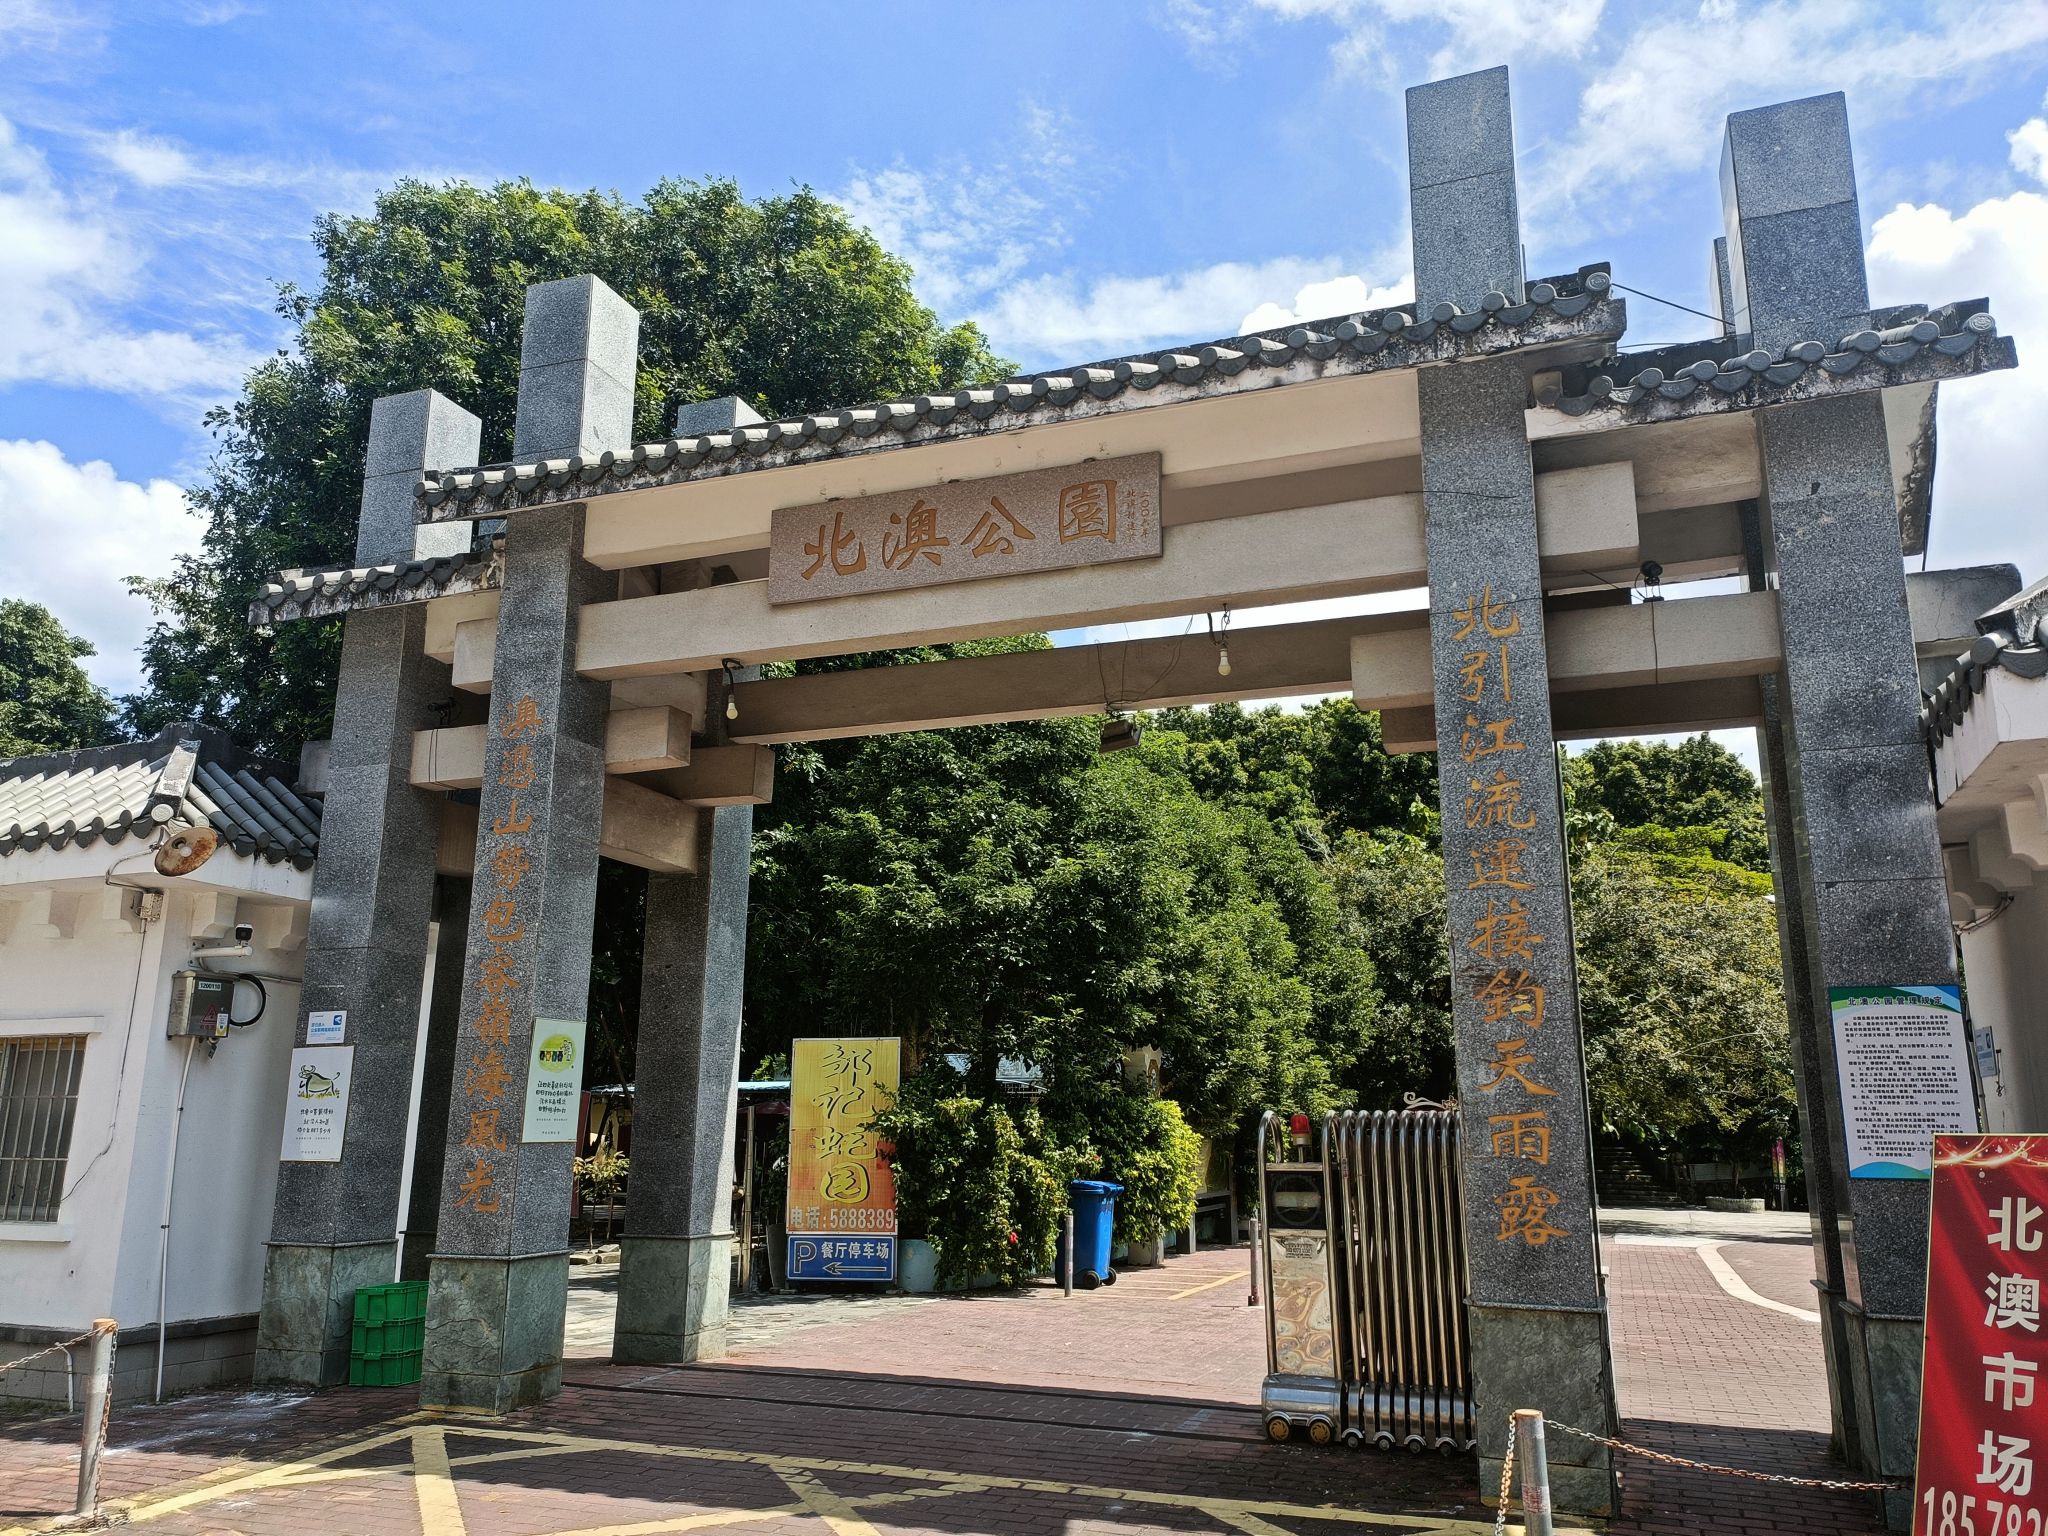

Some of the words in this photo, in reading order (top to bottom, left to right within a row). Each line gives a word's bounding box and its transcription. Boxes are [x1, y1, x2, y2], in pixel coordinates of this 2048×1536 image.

[801, 479, 1117, 581] 北澳公園
[1847, 995, 1943, 1006] 北澳公园管理规定
[821, 1241, 890, 1260] 餐厅停车场
[1976, 1196, 2044, 1497] 北澳市场
